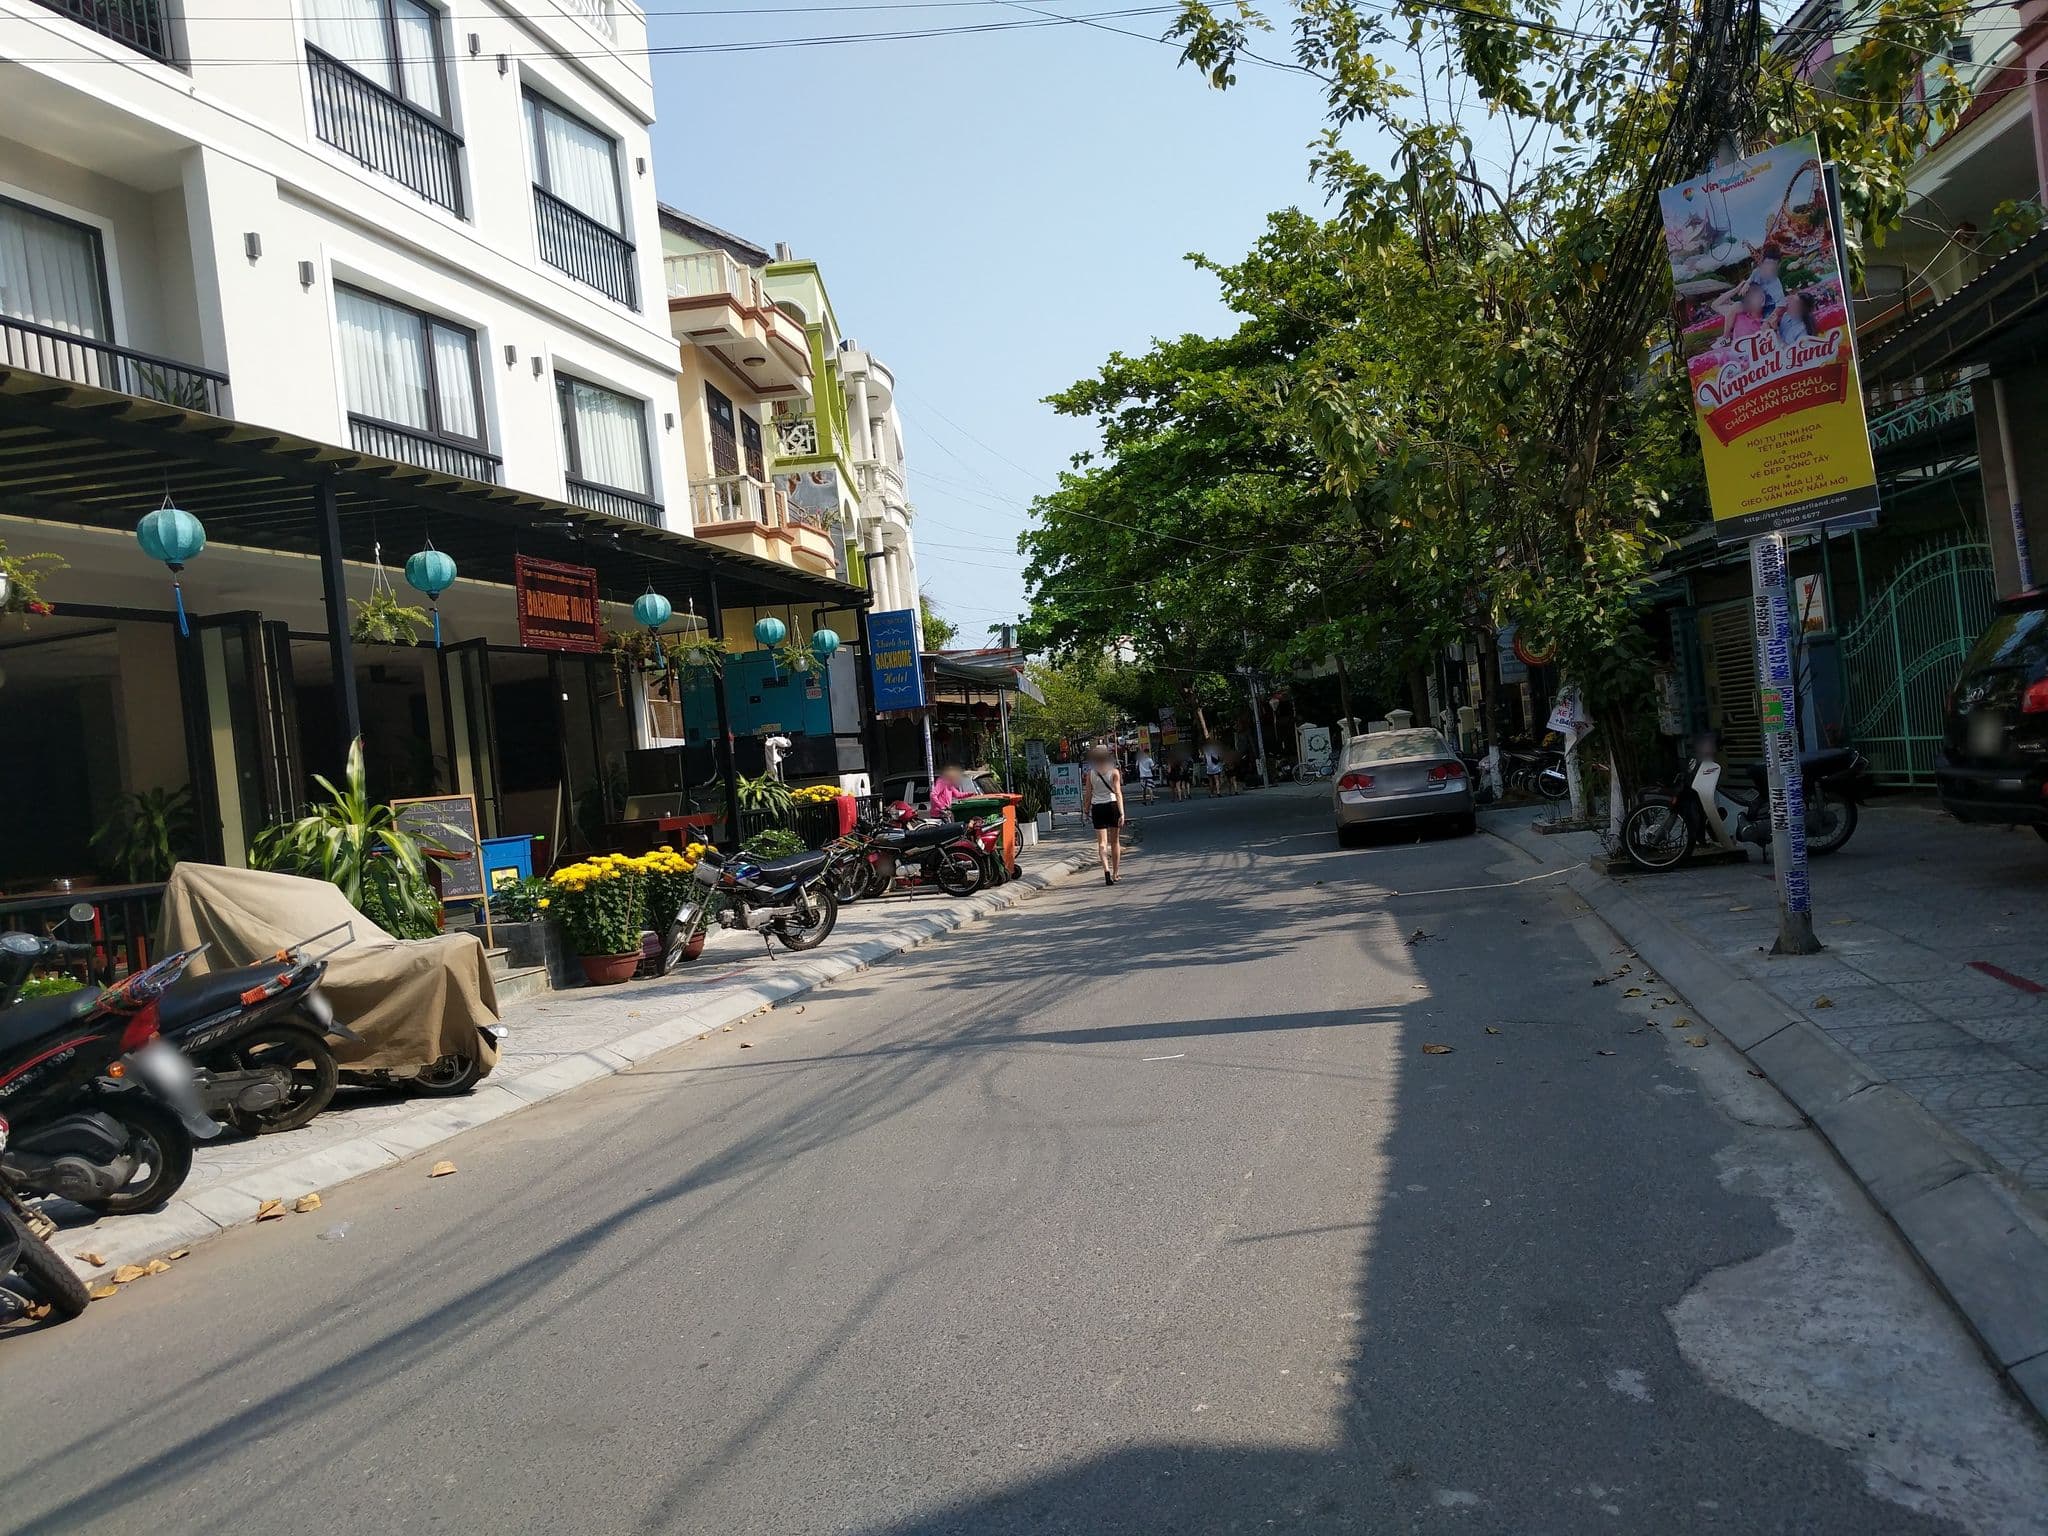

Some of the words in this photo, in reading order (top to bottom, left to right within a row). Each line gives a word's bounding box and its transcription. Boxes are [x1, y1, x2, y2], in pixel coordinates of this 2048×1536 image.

[1700, 352, 1782, 404] Vinpearl
[1786, 331, 1840, 369] Land
[525, 589, 570, 621] BACKHOME
[875, 649, 913, 671] BACKHOME
